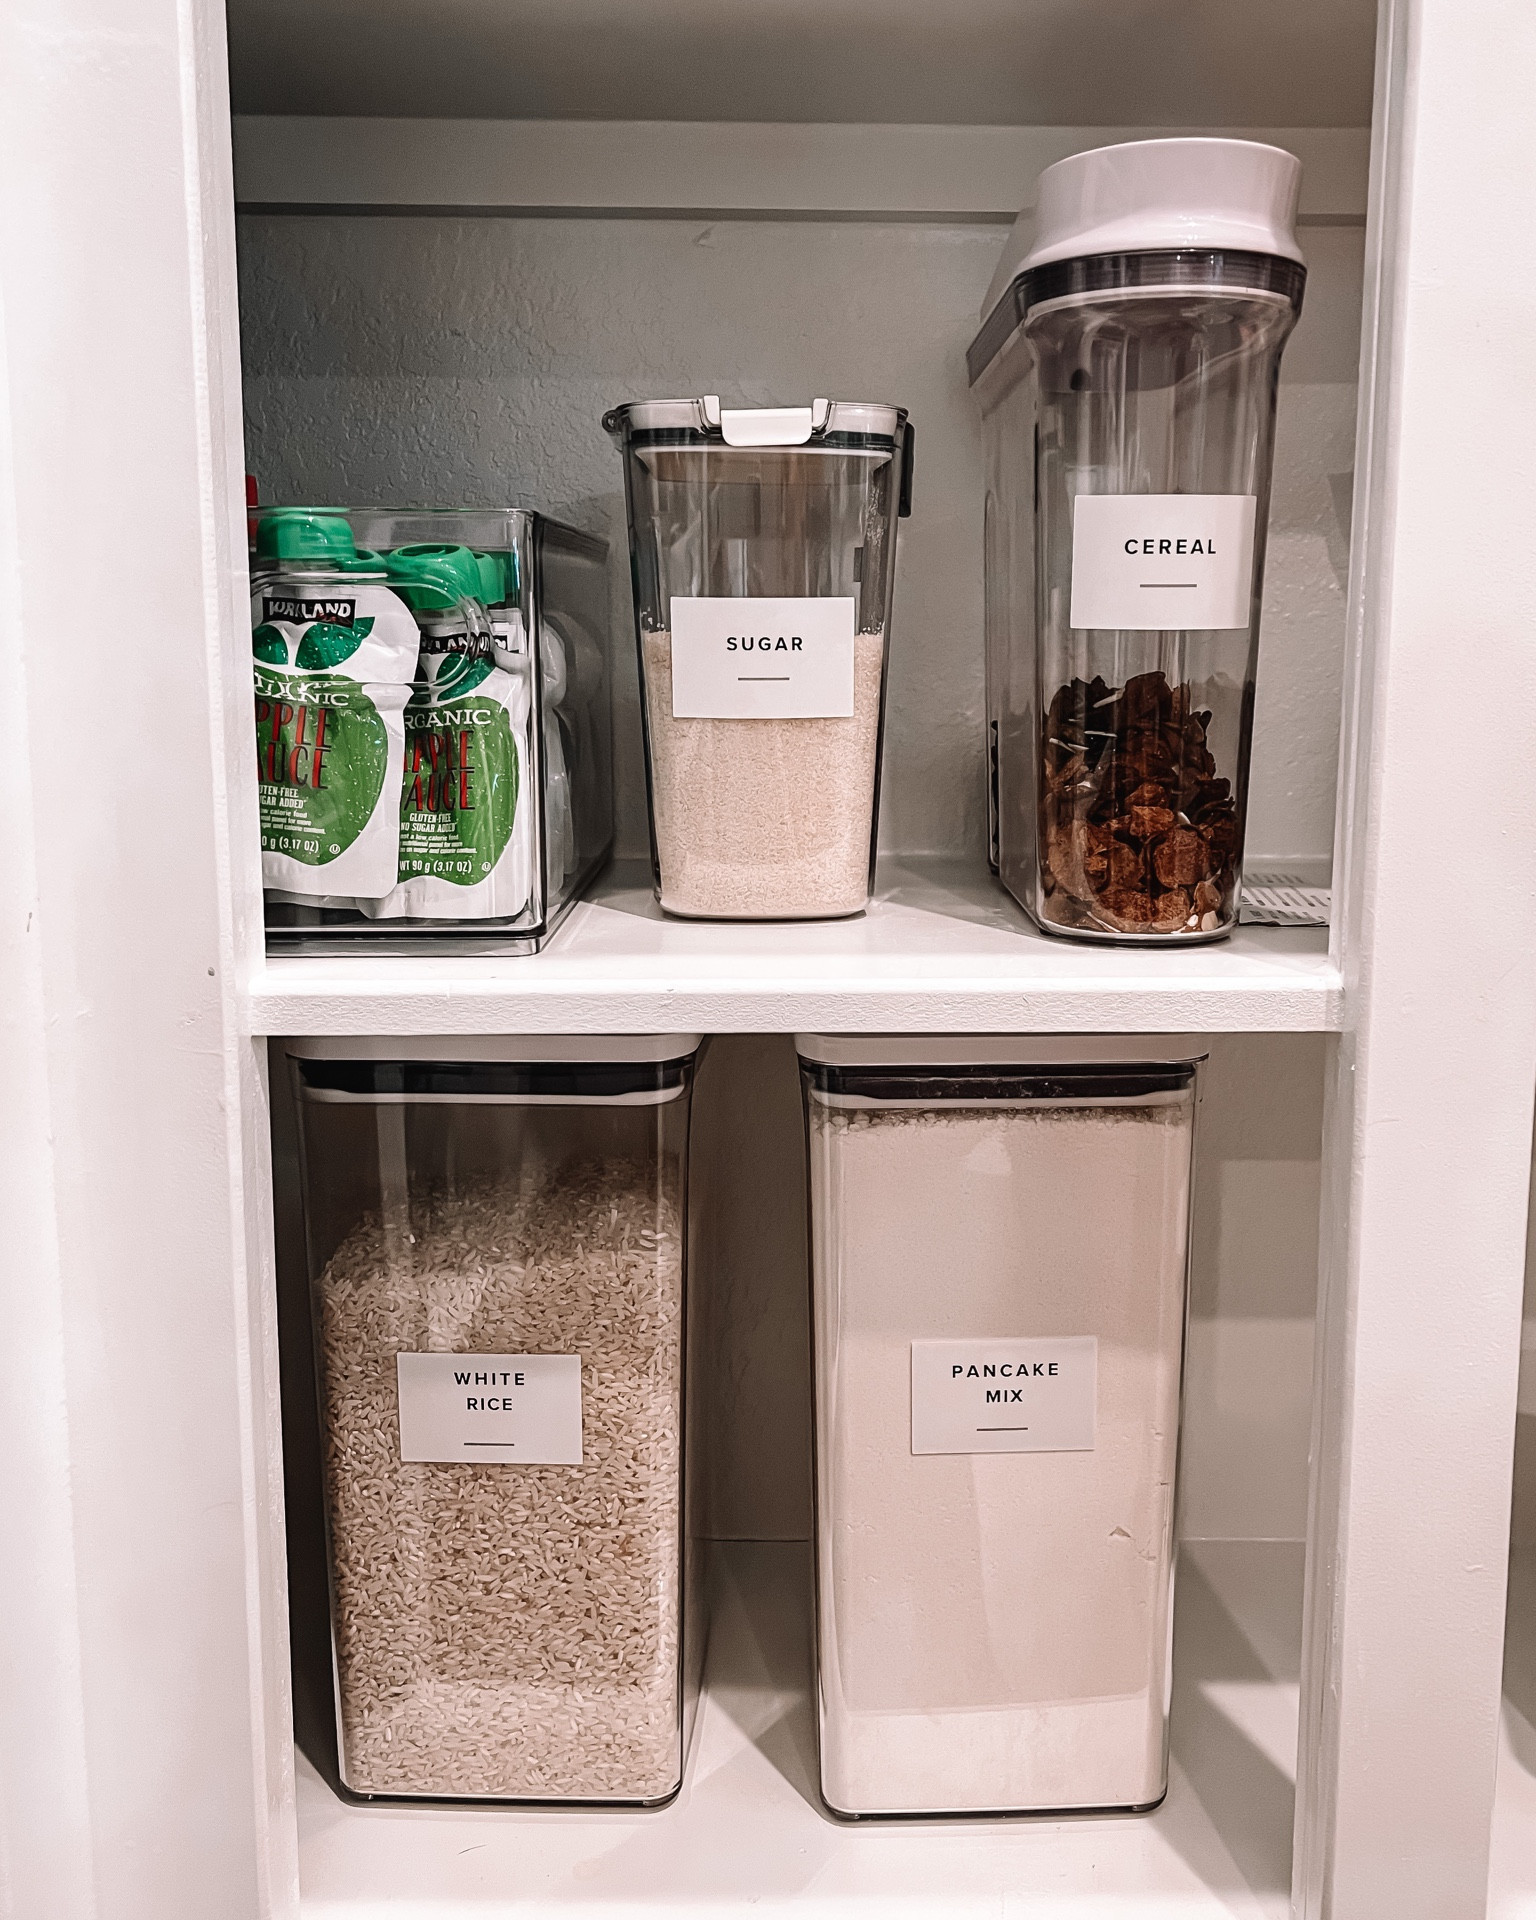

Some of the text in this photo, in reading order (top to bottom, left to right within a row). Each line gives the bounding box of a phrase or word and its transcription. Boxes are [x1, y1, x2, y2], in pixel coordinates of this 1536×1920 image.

[1124, 538, 1217, 555] CEREAL
[726, 636, 803, 651] SUGAR
[411, 823, 436, 832] SUGAR
[412, 860, 423, 869] 90
[952, 1362, 1059, 1379] PANCAKE
[453, 1371, 525, 1386] WHITE
[466, 1397, 513, 1411] RICE
[986, 1389, 1023, 1404] MIX
